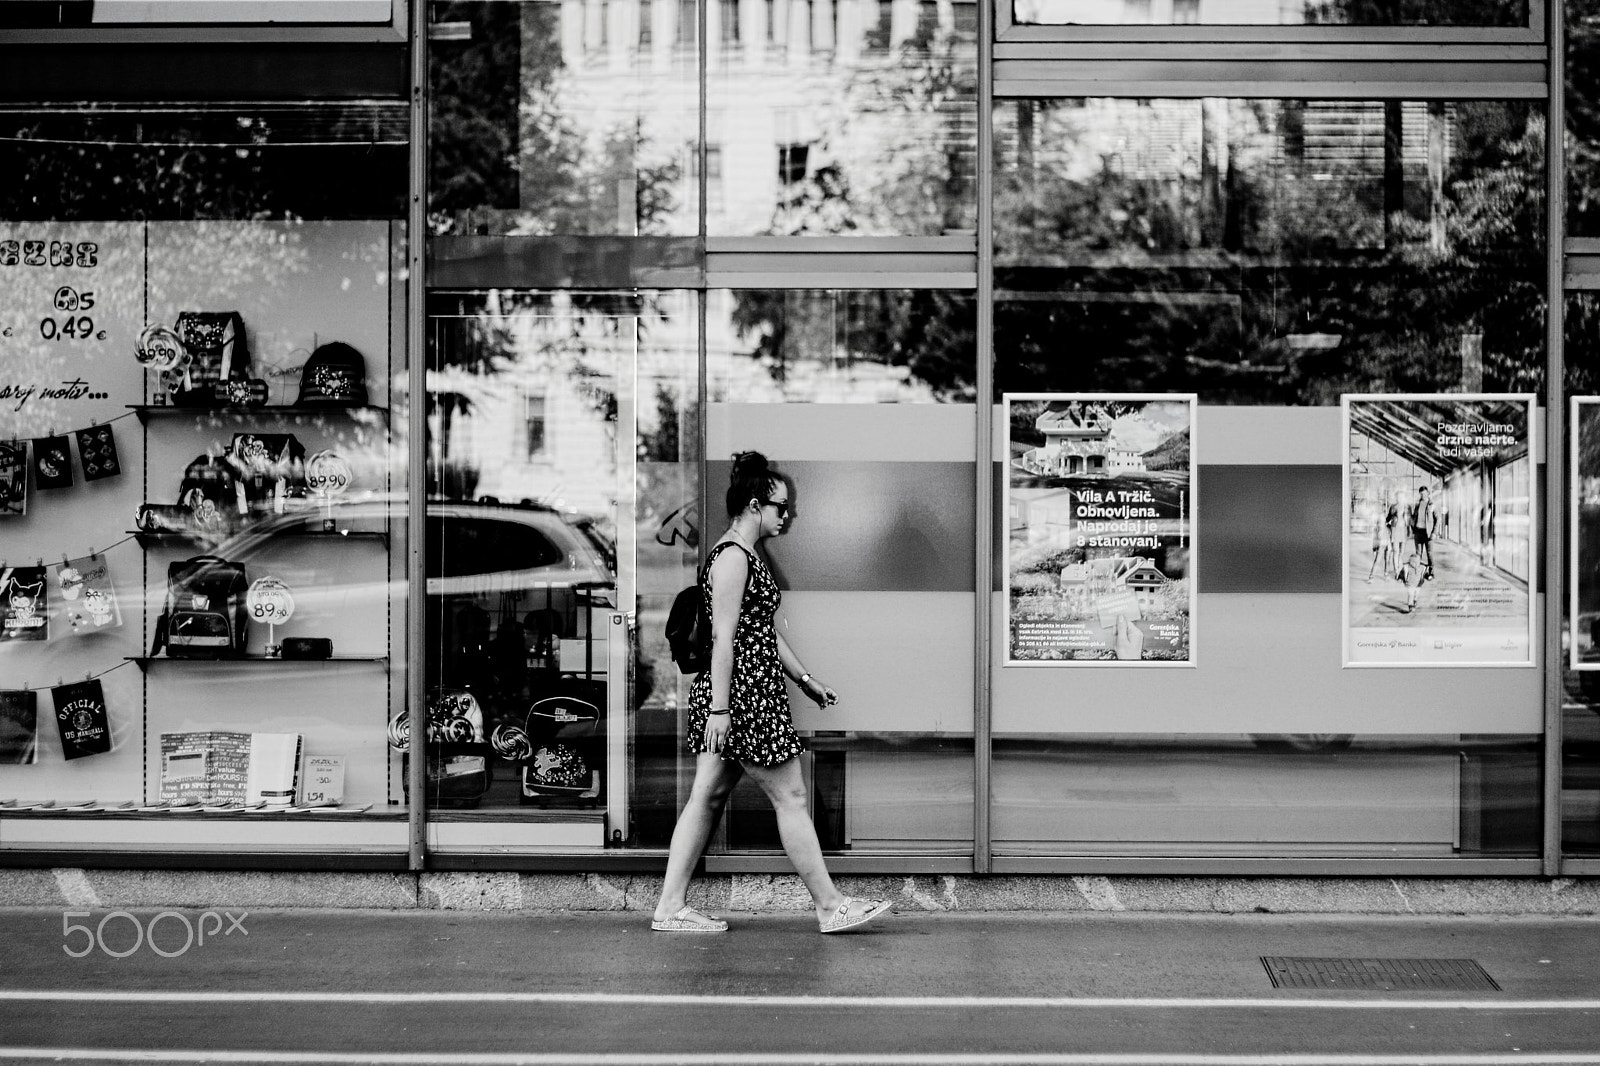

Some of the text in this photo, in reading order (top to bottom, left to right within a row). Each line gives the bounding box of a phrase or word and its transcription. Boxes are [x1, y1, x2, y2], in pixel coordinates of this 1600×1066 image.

[1437, 421, 1514, 435] Pozdravljamo
[1437, 434, 1518, 445] drzne načrte.
[1438, 446, 1494, 457] Tudi vaše!
[1076, 490, 1156, 502] Vila A Tržič.
[1076, 505, 1160, 520] Obnovljena.
[1077, 520, 1158, 534] Naprodaj je
[1076, 535, 1162, 549] 8 stanovanj.
[59, 699, 102, 720] OFFICIAL
[65, 730, 75, 740] US
